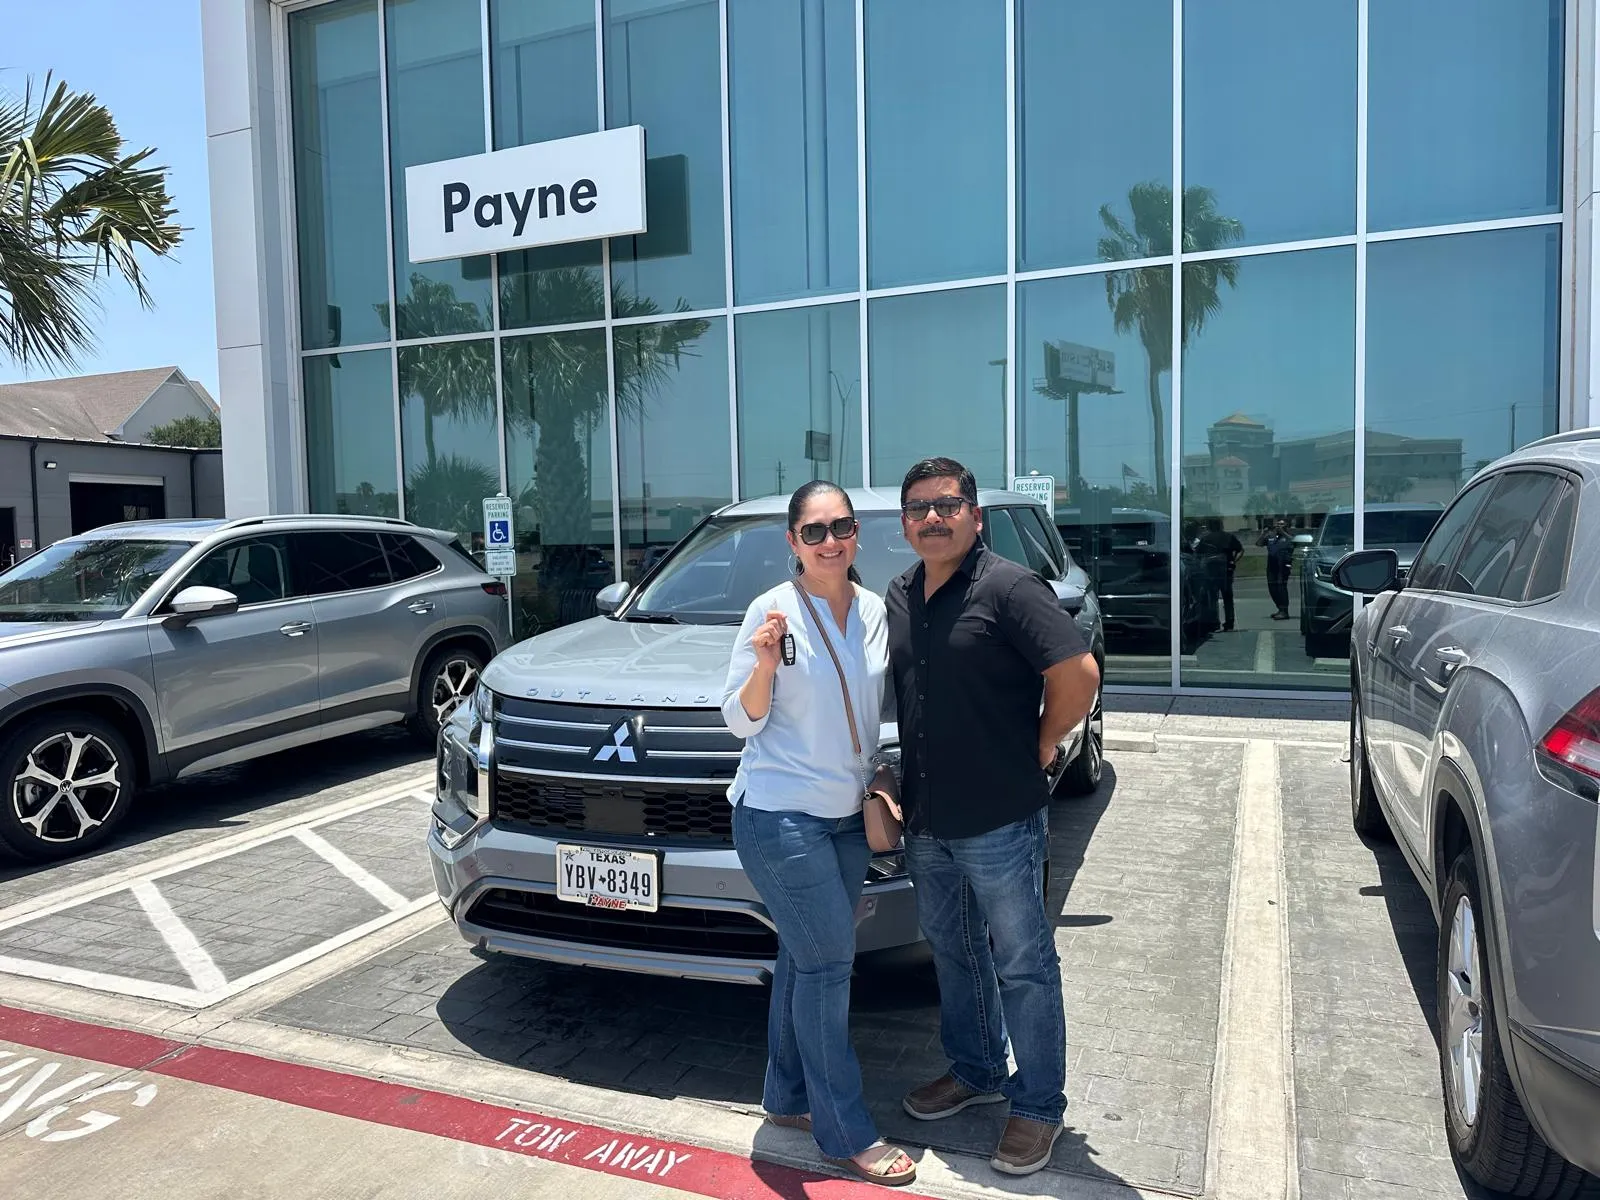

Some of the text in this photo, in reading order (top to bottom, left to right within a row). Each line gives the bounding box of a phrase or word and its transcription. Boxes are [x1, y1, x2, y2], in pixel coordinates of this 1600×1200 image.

[443, 178, 598, 237] Payne
[1016, 482, 1050, 492] RESERVED
[526, 687, 710, 704] OUTLAND
[590, 853, 626, 865] TEXAS
[565, 864, 651, 897] YBV 8349
[495, 1118, 693, 1176] TOW AWAY
